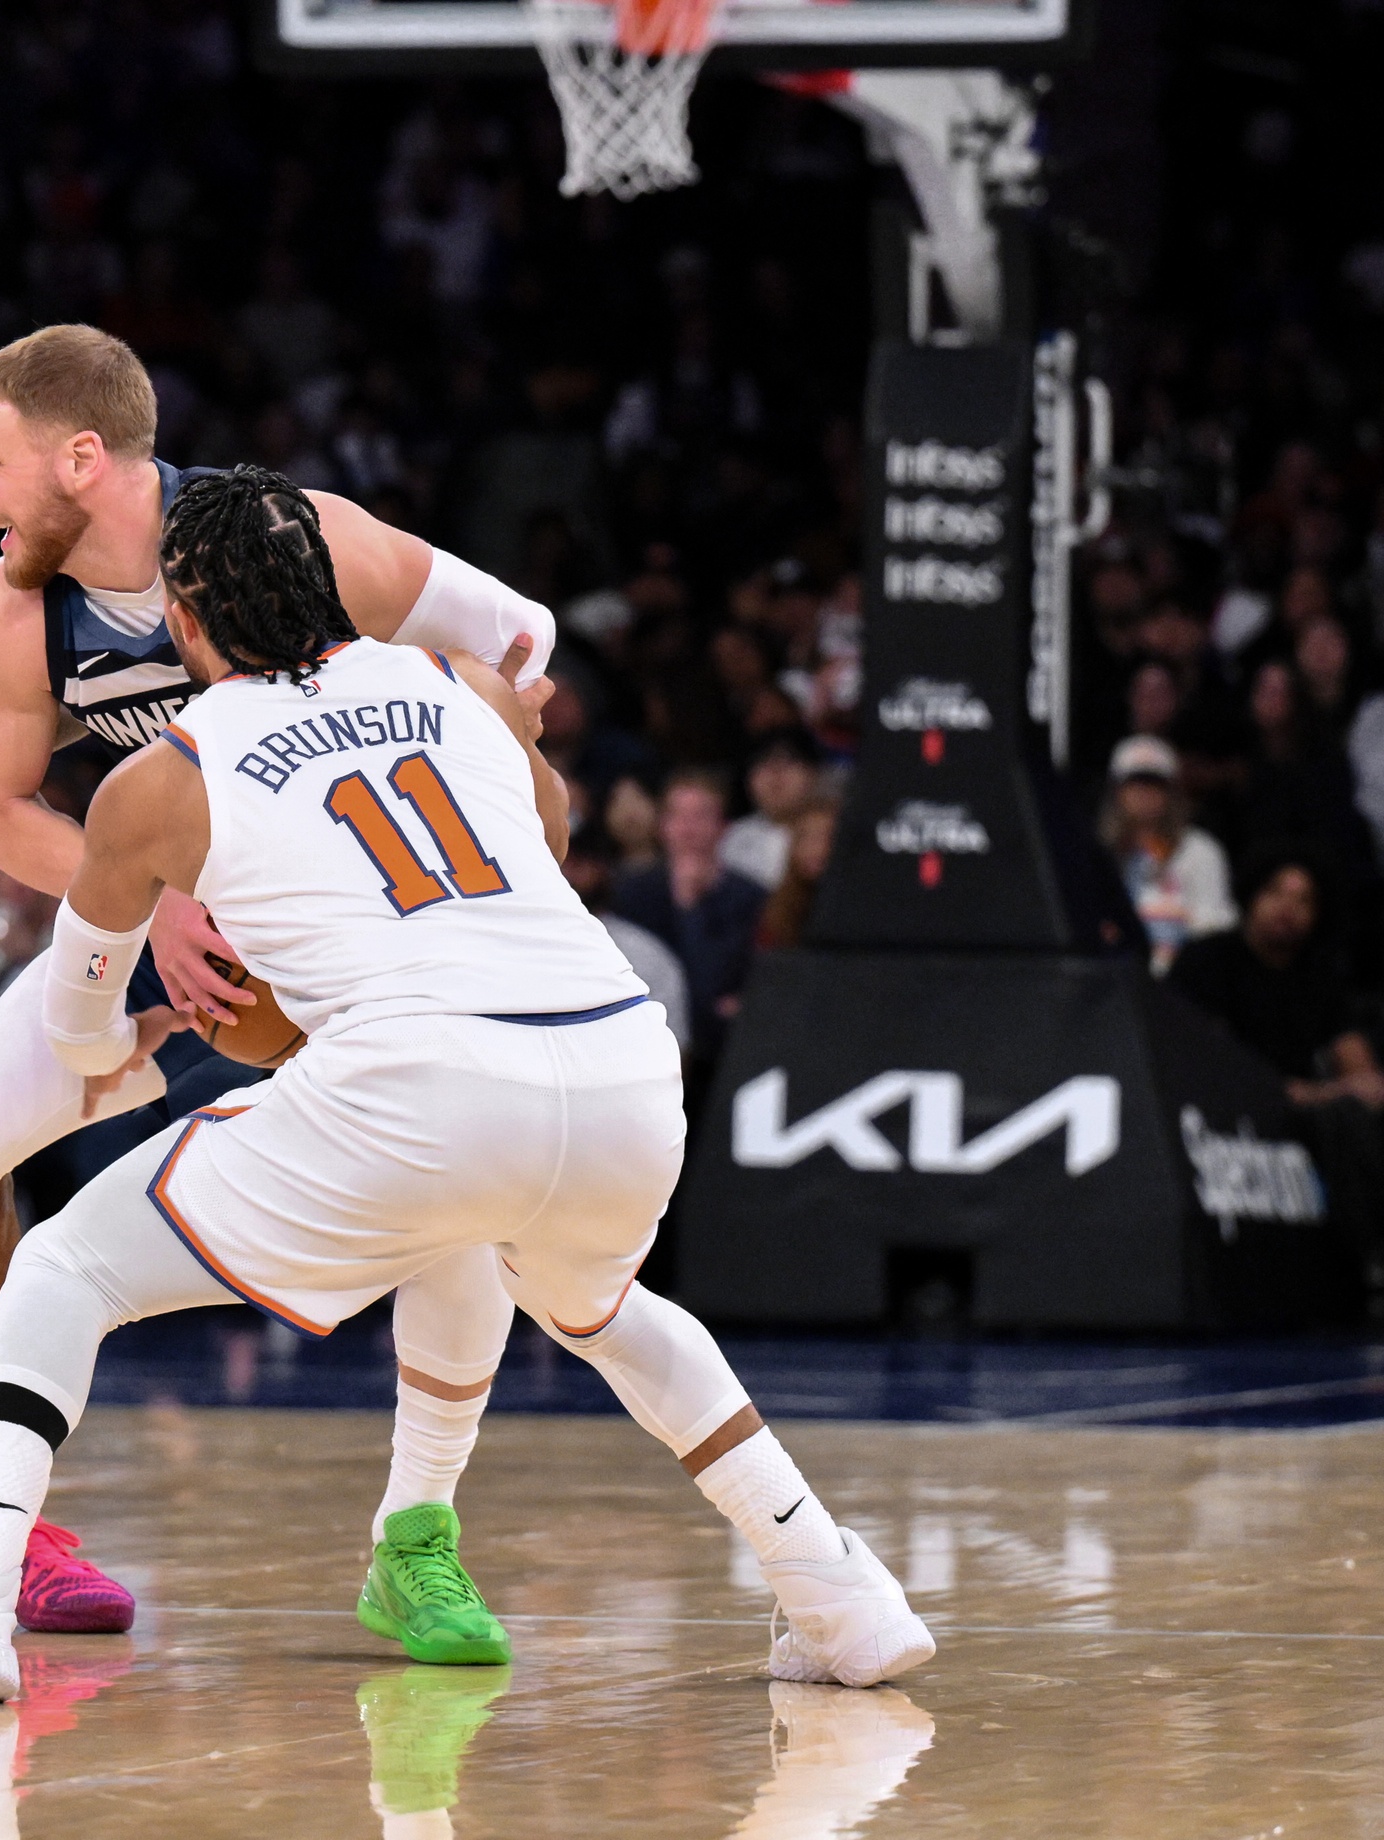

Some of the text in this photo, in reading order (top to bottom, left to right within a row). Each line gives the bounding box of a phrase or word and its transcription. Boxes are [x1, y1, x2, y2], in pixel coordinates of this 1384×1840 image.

[86, 694, 202, 747] INNE
[234, 700, 445, 794] BRUNSON
[322, 749, 514, 918] 11
